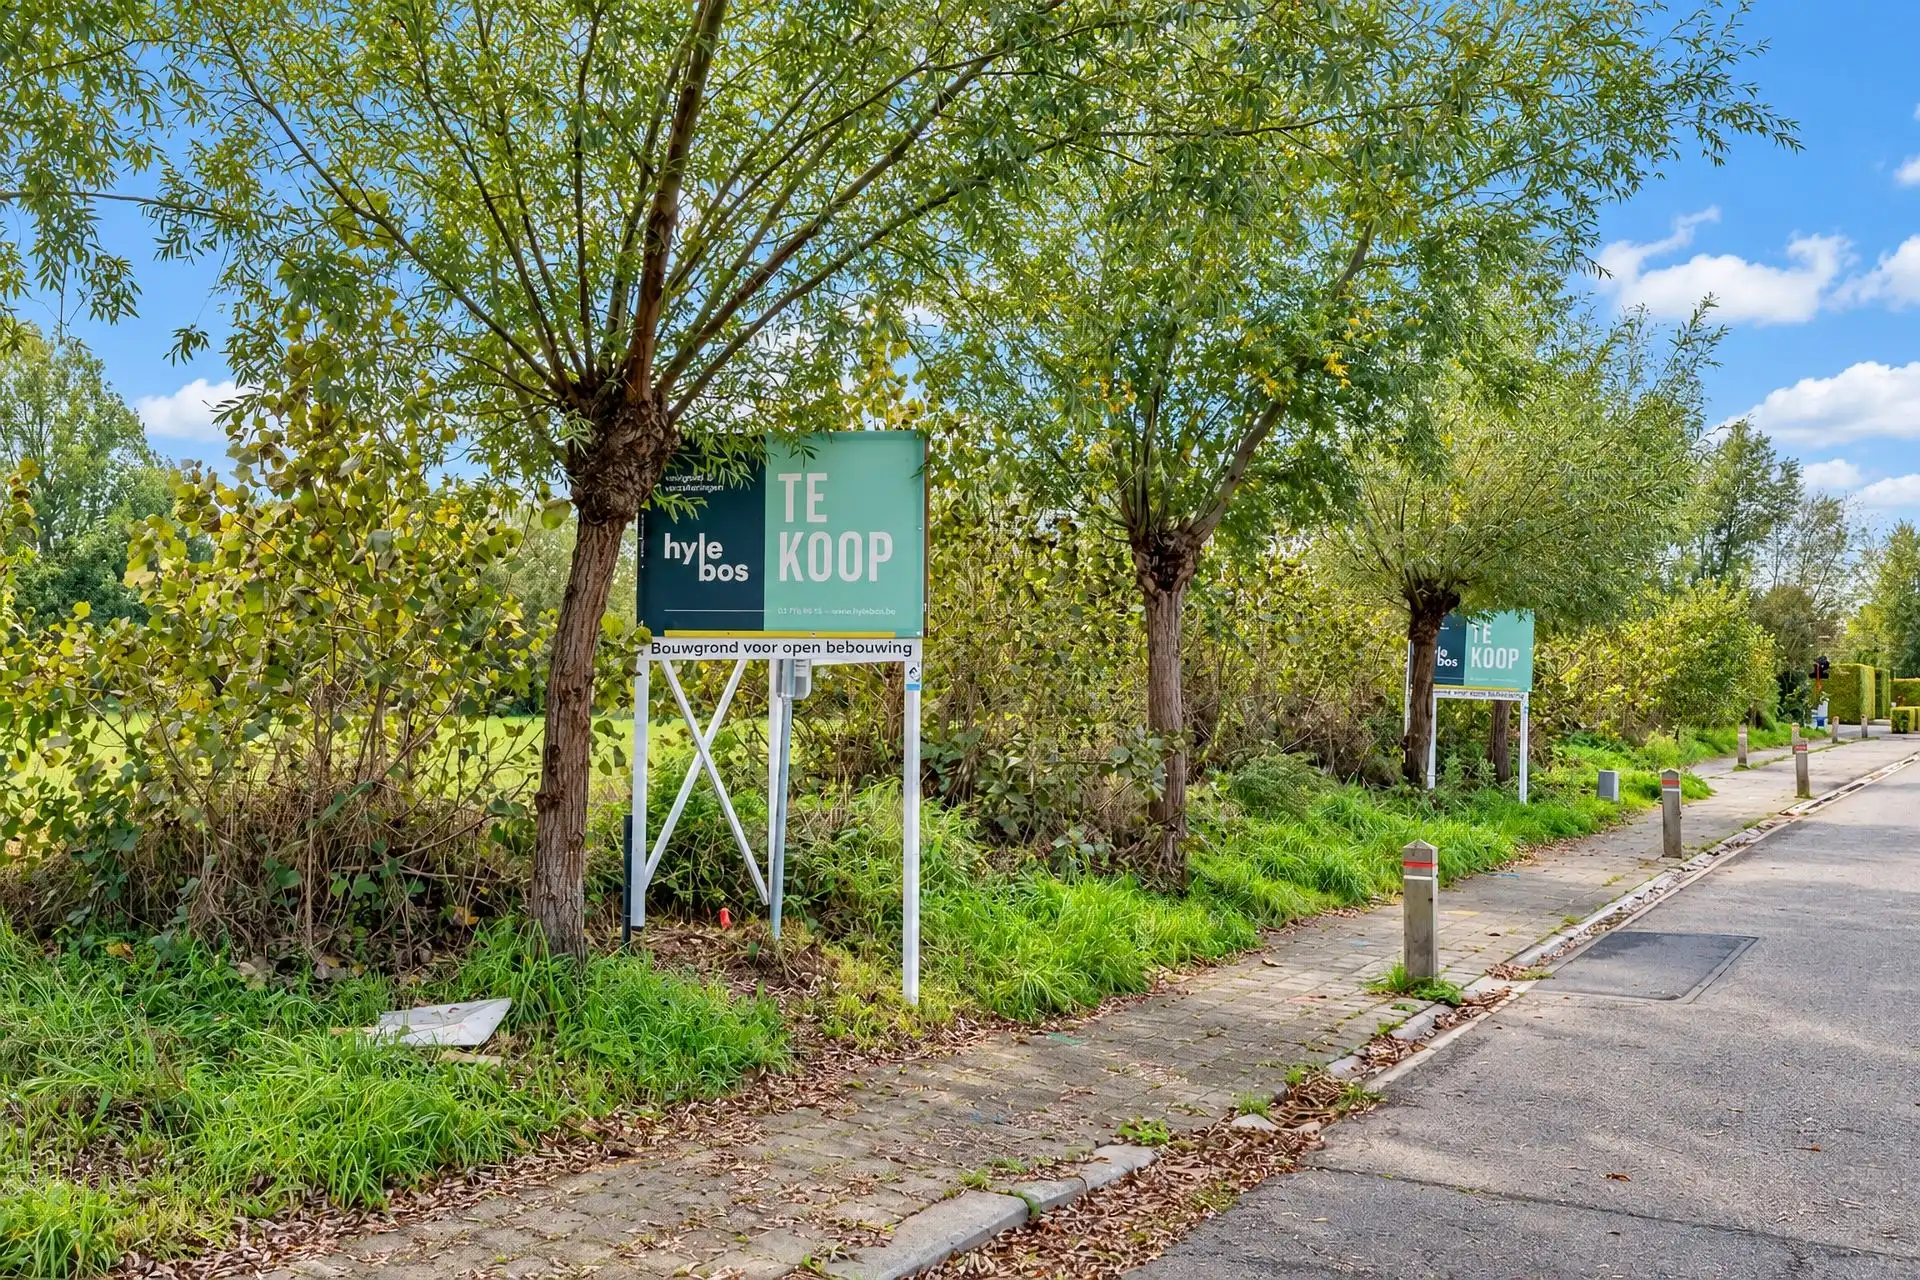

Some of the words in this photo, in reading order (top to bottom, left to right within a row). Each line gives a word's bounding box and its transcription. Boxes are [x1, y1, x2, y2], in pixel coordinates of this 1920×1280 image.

[778, 472, 828, 523] TE
[664, 532, 723, 565] hyle
[779, 531, 894, 582] KOOP
[698, 556, 749, 582] bos
[651, 641, 739, 657] Bouwgrond
[743, 643, 778, 654] voor
[782, 643, 821, 656] open
[826, 640, 913, 657] bebouwing
[1437, 654, 1458, 667] bos
[1471, 647, 1520, 669] KOOP
